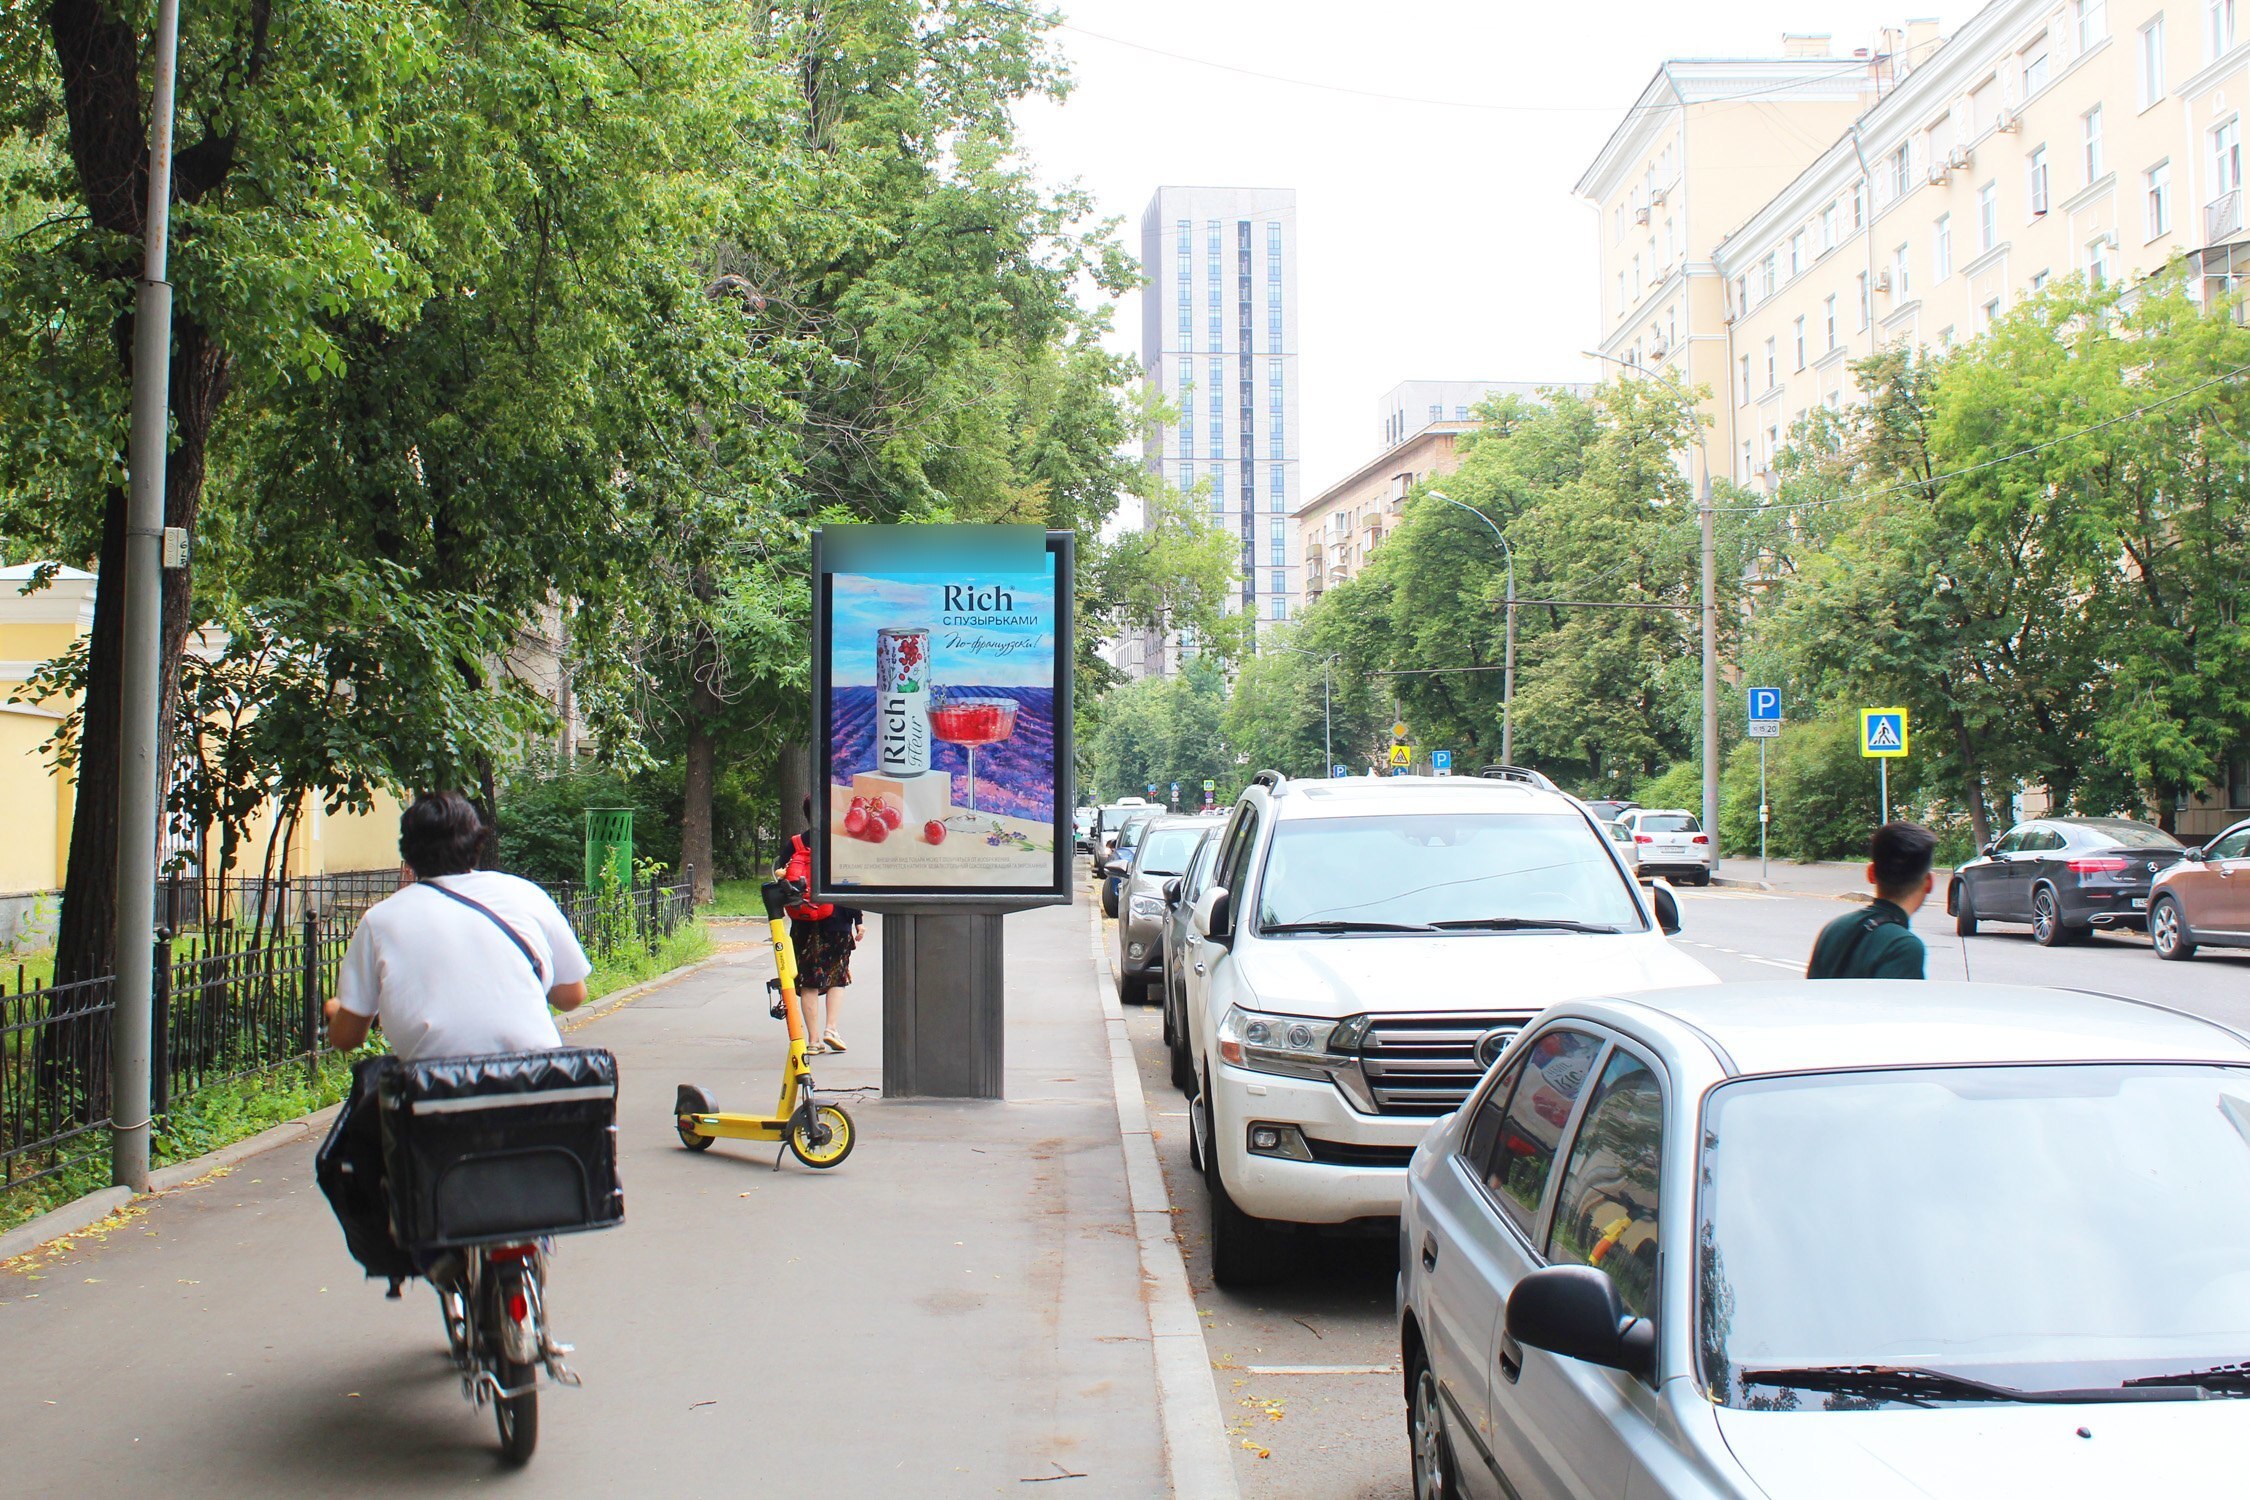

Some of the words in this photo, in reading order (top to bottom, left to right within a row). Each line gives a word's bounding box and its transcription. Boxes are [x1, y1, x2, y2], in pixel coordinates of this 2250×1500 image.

[943, 585, 1013, 612] Rich
[942, 616, 952, 626] С
[954, 616, 1038, 626] ПУЗЫРЬКАМИ
[944, 631, 1042, 657] По-французски!
[1758, 691, 1775, 716] P
[884, 698, 906, 765] Rich
[907, 715, 923, 767] Fleur
[1437, 753, 1447, 767] P
